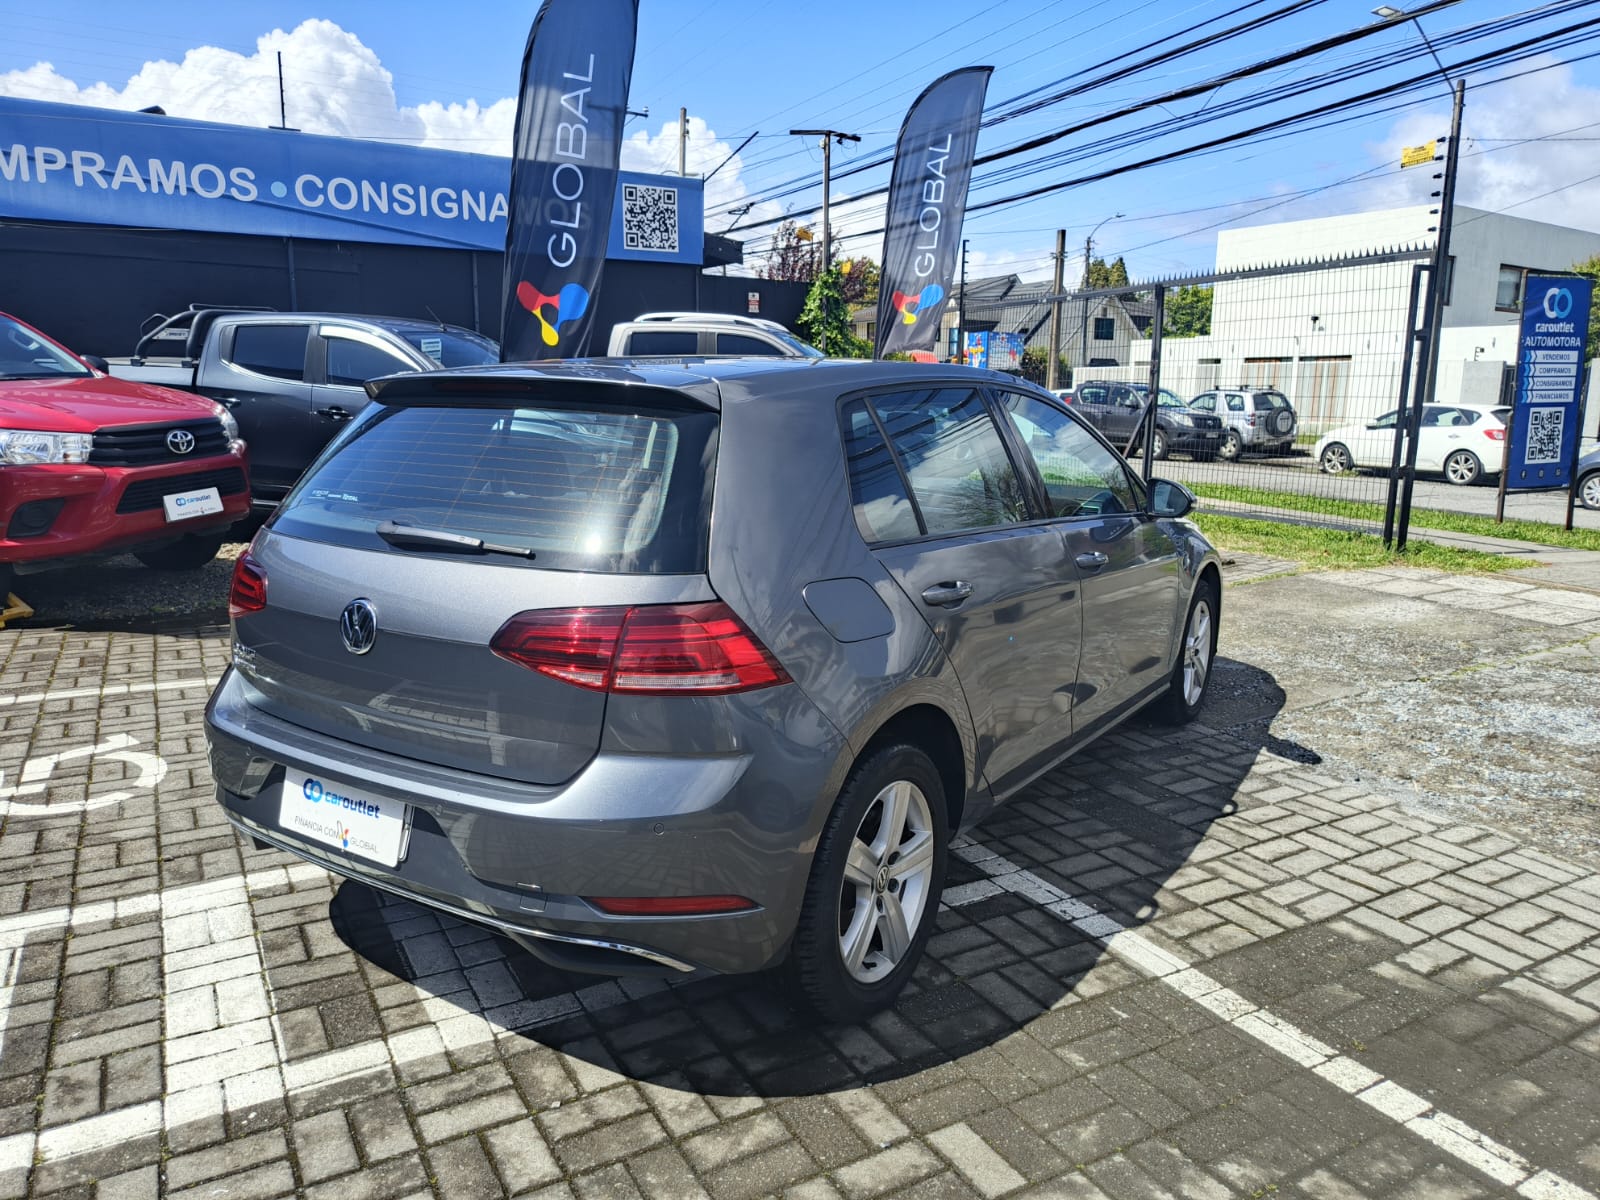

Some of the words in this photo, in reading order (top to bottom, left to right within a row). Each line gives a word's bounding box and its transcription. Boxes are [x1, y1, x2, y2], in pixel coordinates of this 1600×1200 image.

[546, 53, 595, 268] GLOBAL
[914, 133, 953, 278] GLOBAL
[1535, 321, 1575, 333] caroutlet
[1524, 336, 1581, 347] AUTOMOTORA
[1542, 353, 1571, 361] VENDEMOS
[1538, 367, 1572, 375] COMPRAMOS
[325, 790, 380, 818] caroutlet
[294, 815, 323, 833] FINANCIA
[350, 836, 380, 853] GLOBAL
